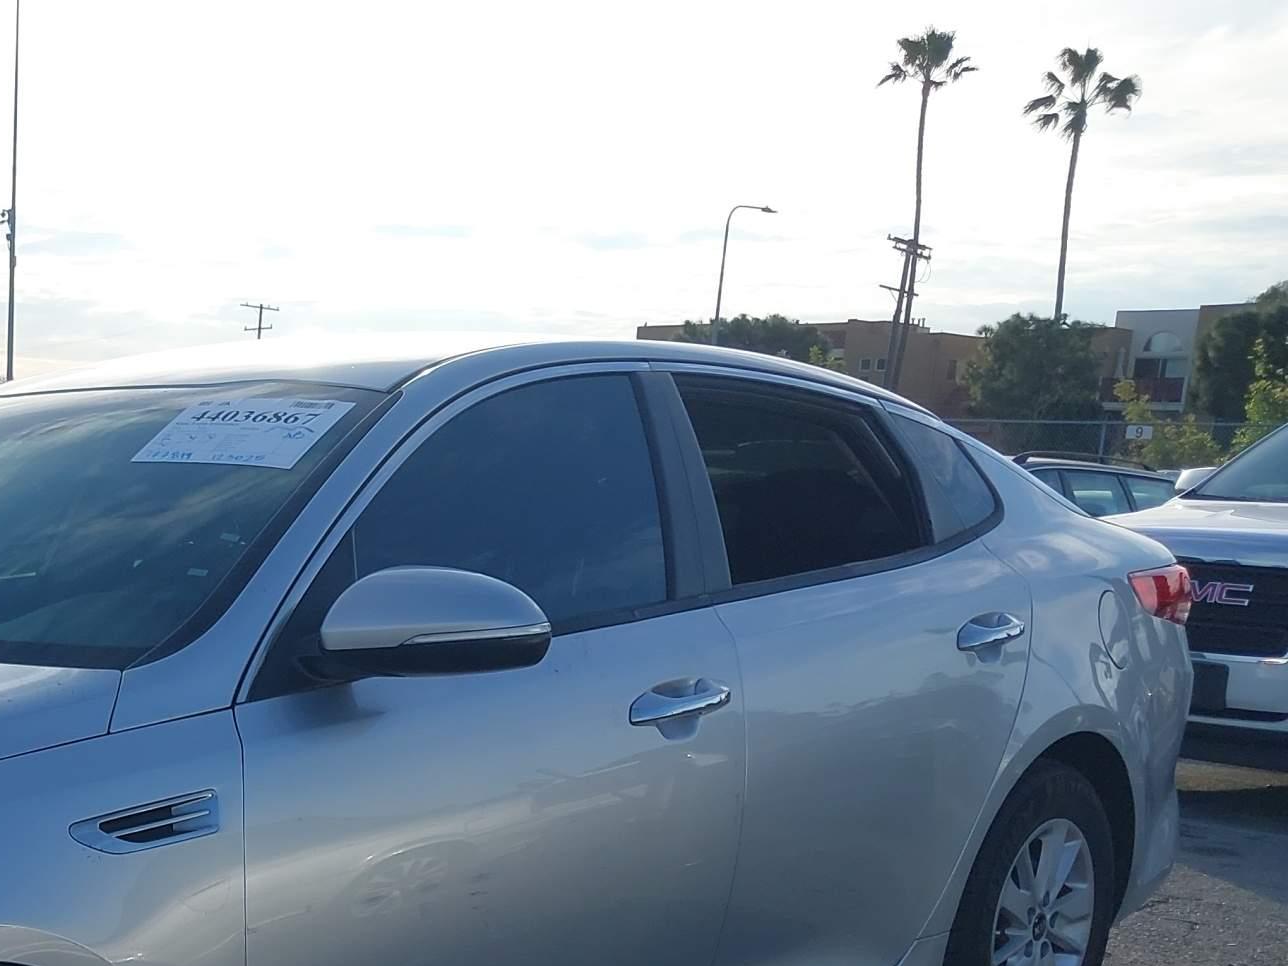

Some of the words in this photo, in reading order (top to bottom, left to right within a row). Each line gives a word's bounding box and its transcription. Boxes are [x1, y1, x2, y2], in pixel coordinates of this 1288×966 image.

[192, 409, 321, 426] 44036867
[1135, 426, 1144, 439] 9
[1190, 580, 1254, 606] MC
